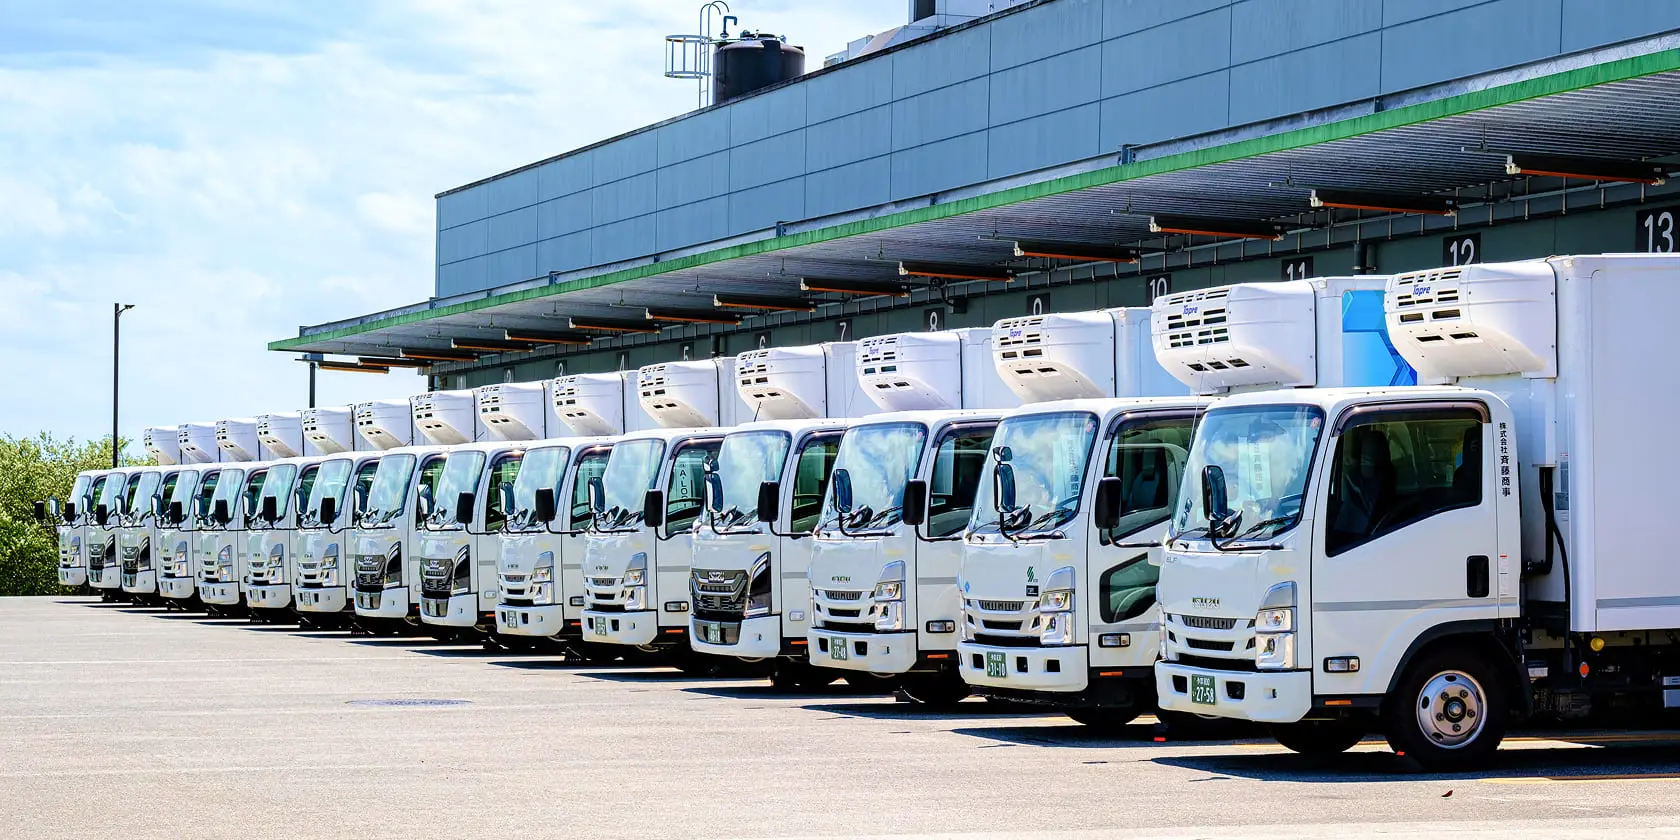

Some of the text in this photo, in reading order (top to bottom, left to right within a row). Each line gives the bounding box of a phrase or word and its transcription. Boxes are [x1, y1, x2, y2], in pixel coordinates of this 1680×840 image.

[1644, 211, 1674, 253] 13
[1450, 238, 1475, 266] 12
[1286, 261, 1305, 281] 11
[1149, 277, 1167, 303] 10
[1413, 284, 1431, 296] Topre
[1196, 686, 1214, 703] 27-58
